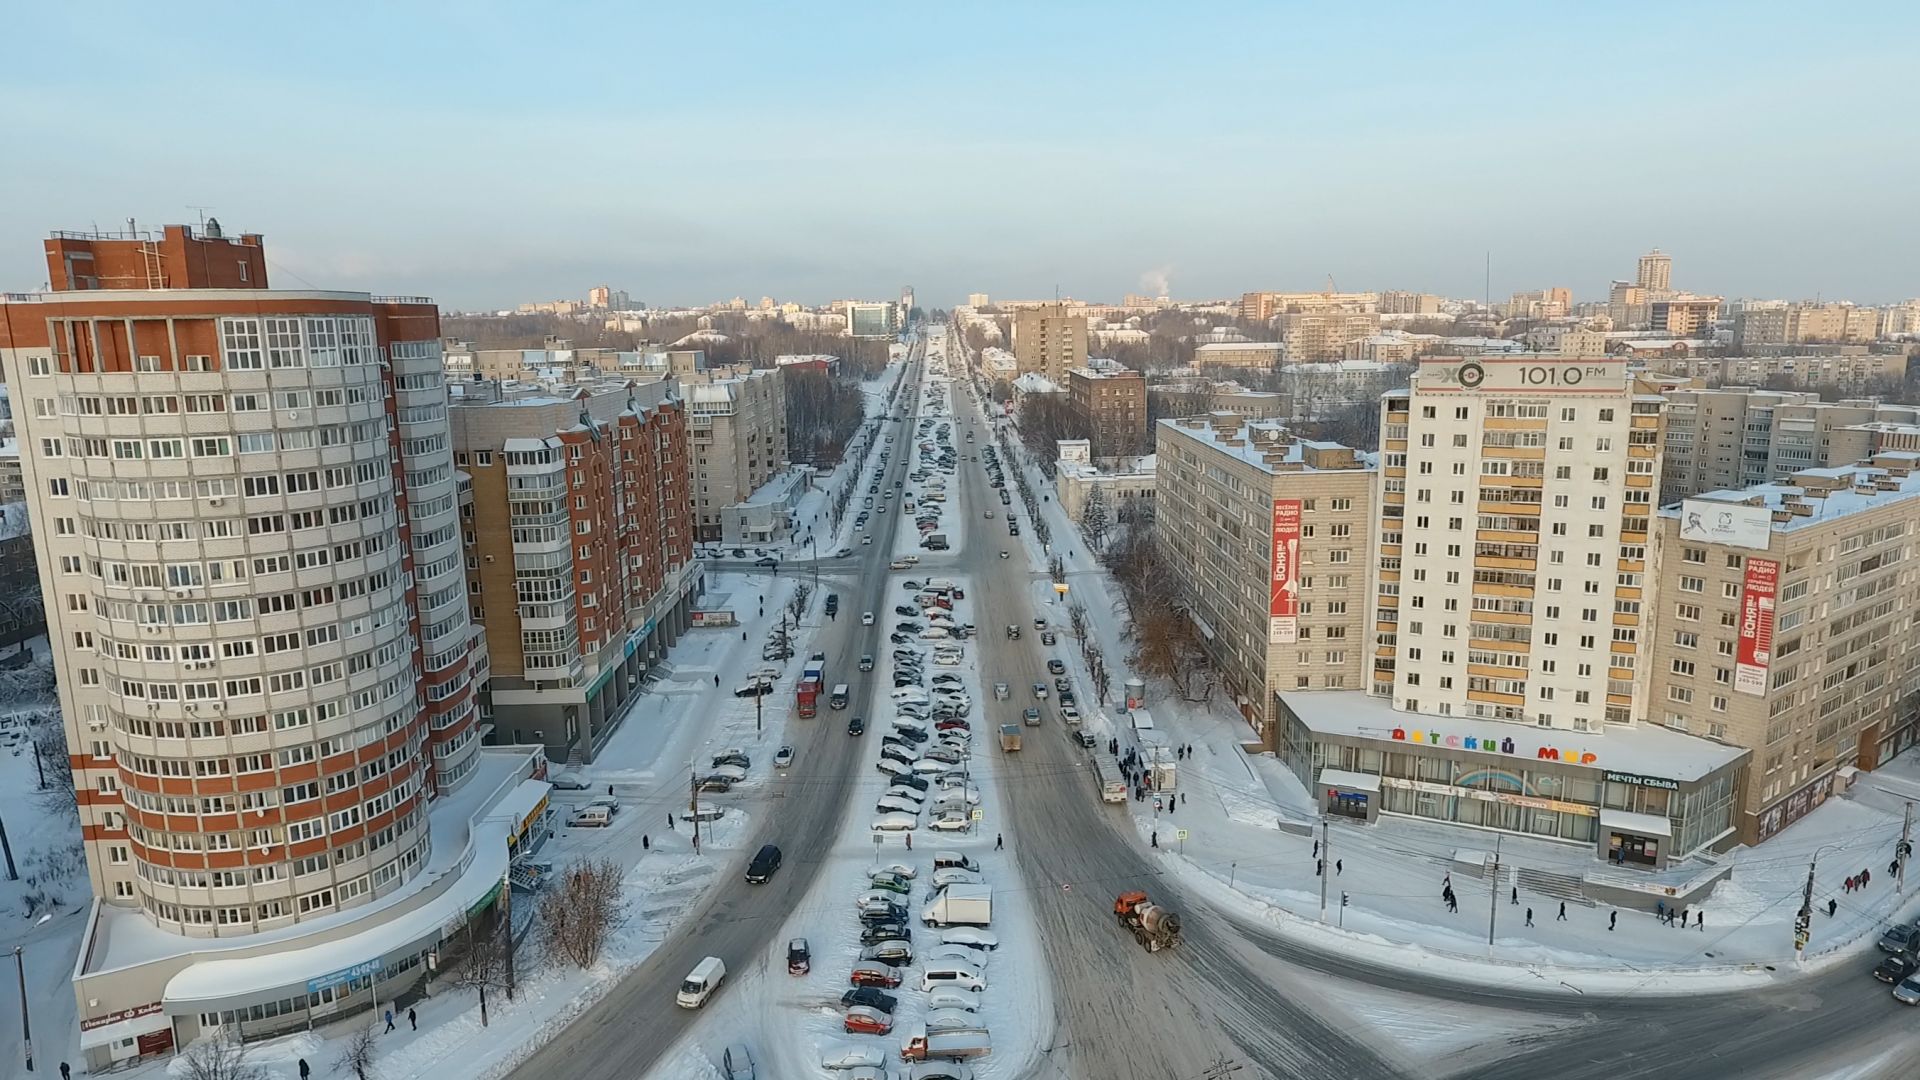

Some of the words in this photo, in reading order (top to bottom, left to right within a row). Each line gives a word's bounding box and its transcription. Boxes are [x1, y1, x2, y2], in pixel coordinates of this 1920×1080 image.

[1586, 367, 1606, 377] FM
[1748, 565, 1776, 574] РАДИО
[1746, 583, 1775, 593] ЛЮДЕЙ
[1607, 773, 1642, 784] МЕЧТЫ
[1643, 778, 1678, 790] СБЫВА
